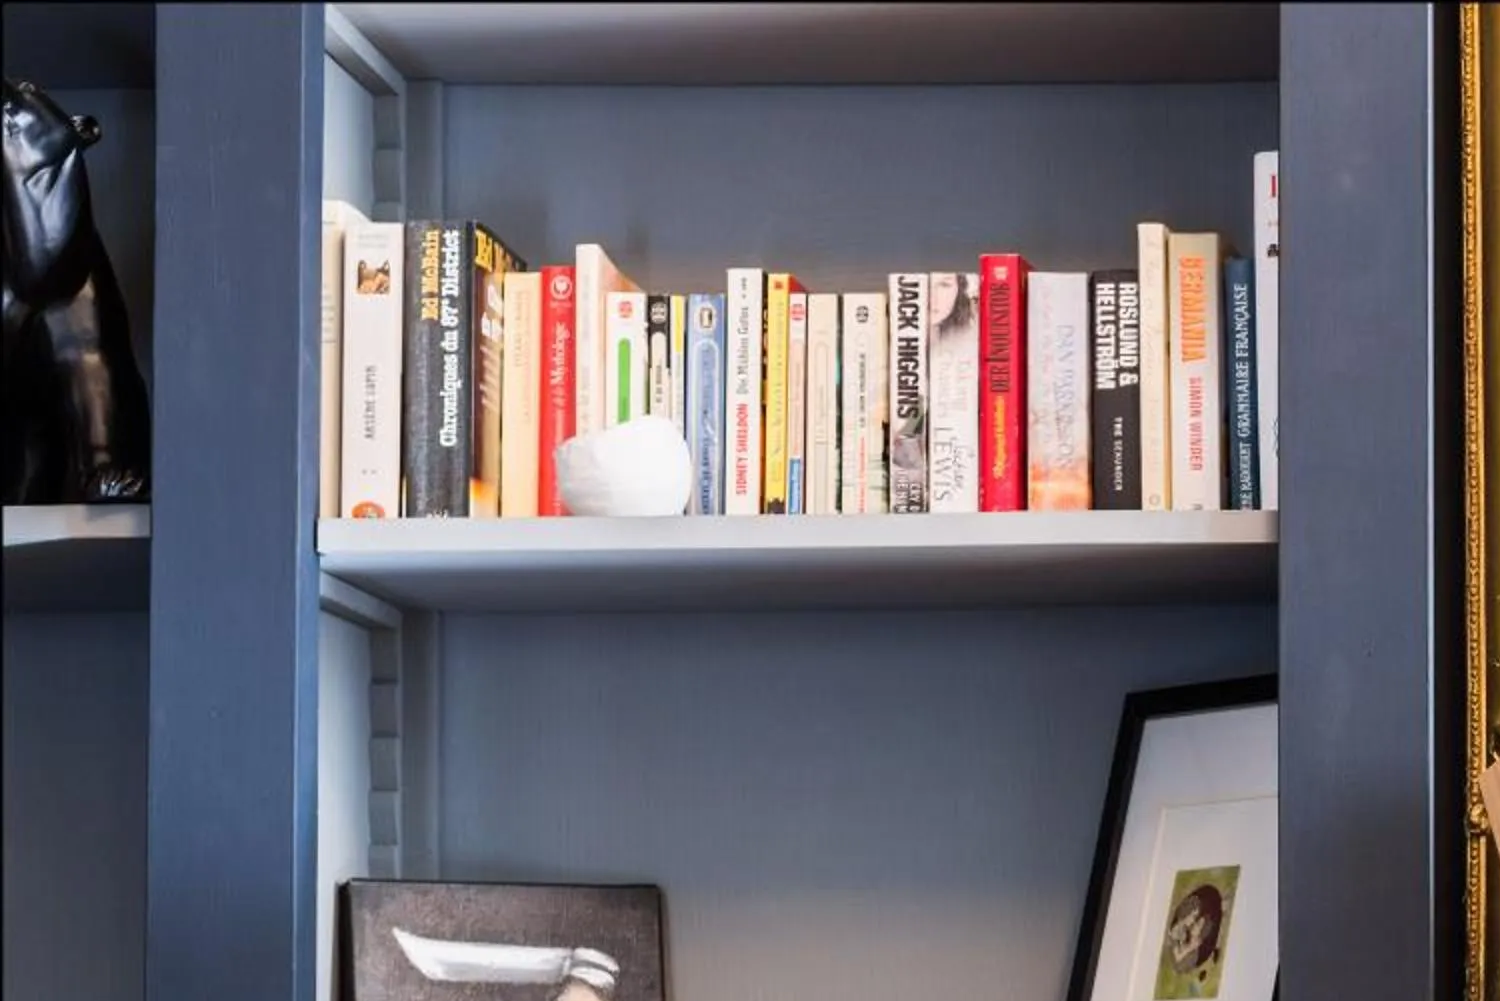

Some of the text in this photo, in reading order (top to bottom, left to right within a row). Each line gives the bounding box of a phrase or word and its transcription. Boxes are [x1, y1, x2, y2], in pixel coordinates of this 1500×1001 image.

[440, 230, 459, 298] District
[441, 330, 459, 351] du
[896, 275, 920, 421] JACK HIGGINS
[990, 365, 1010, 393] DER
[1095, 281, 1119, 389] HELLSTRÖM
[1118, 281, 1139, 387] ROSLUND &
[1232, 282, 1251, 437] GRAMMAIRE FRANÇAISE
[440, 354, 463, 447] Chroniques
[1187, 376, 1203, 471] SIMON WINDER
[735, 403, 748, 496] SIDNEY SHELDON
[933, 426, 955, 502] LEWIS
